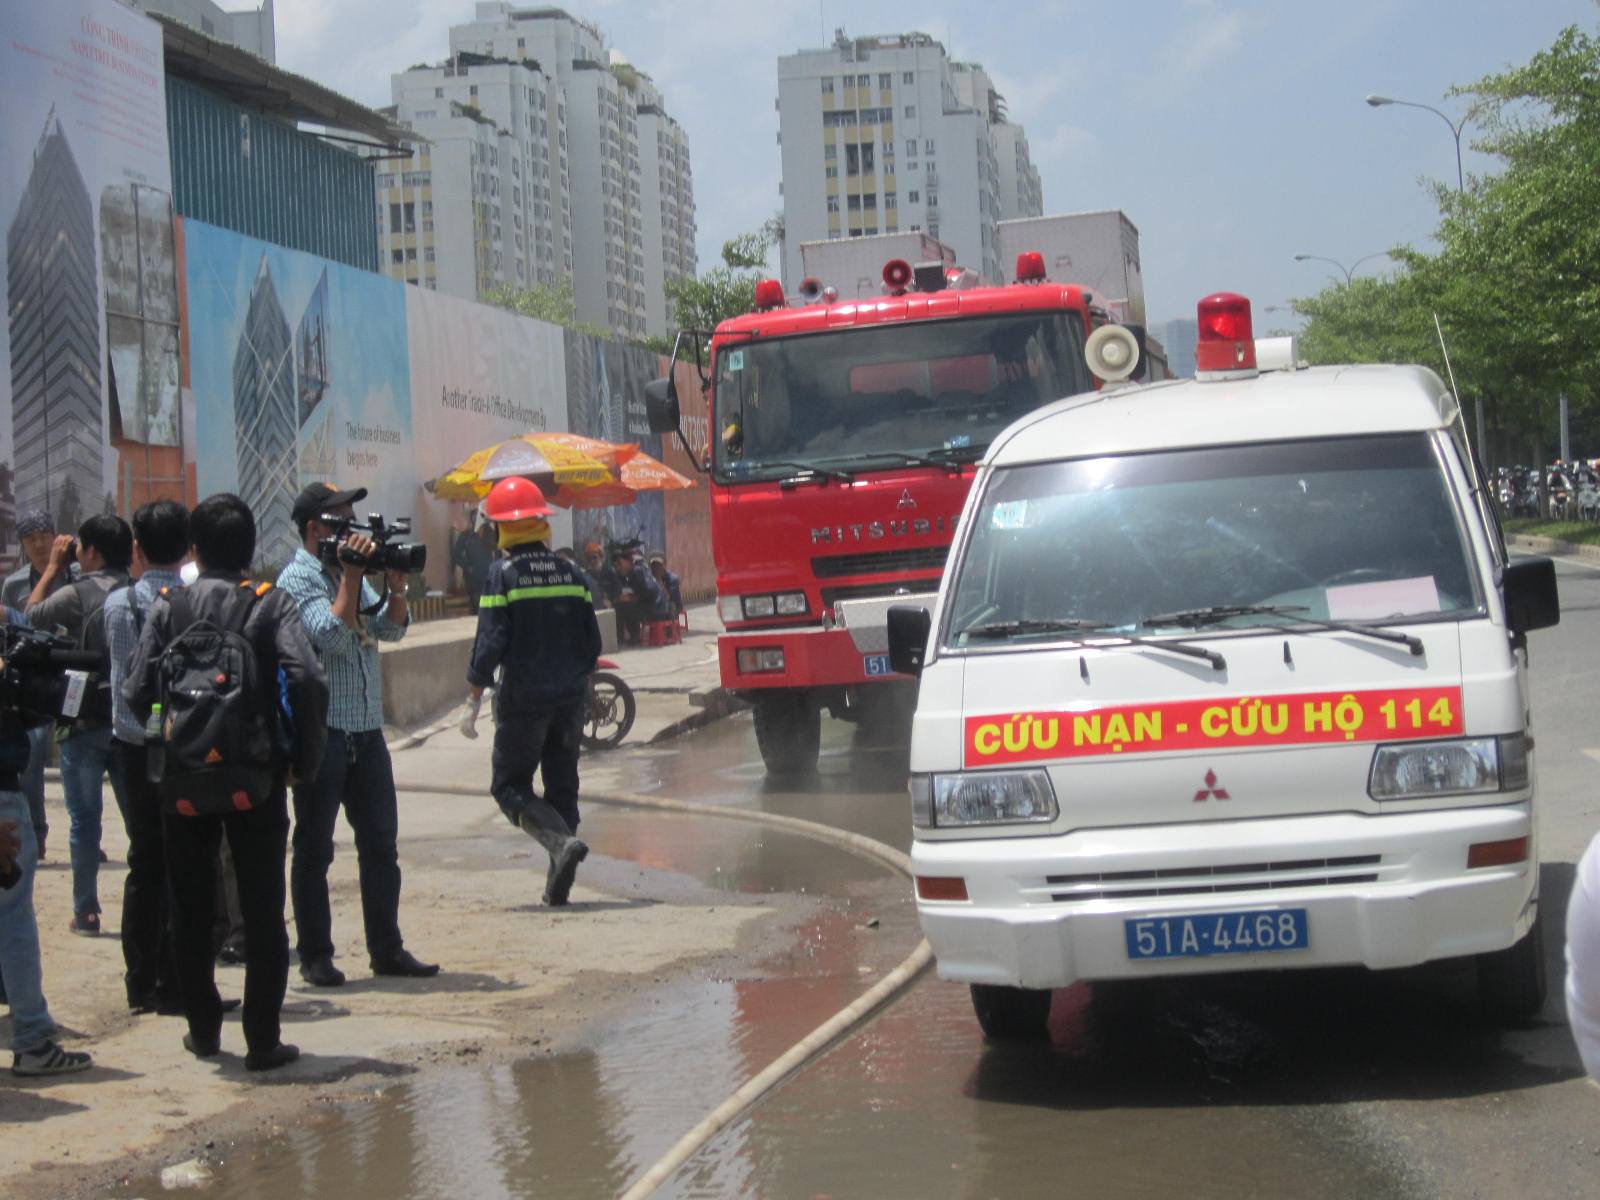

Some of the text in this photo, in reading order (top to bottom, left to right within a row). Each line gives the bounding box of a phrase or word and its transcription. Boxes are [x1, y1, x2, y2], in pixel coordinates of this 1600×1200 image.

[441, 384, 467, 410] Another
[346, 421, 357, 440] The
[974, 714, 1060, 755] CỨU
[1073, 710, 1162, 752] NẠN
[1200, 696, 1288, 738] CỨU
[1304, 694, 1364, 740] HỘ
[1380, 697, 1453, 730] 114
[1136, 912, 1297, 955] 51A-4468
